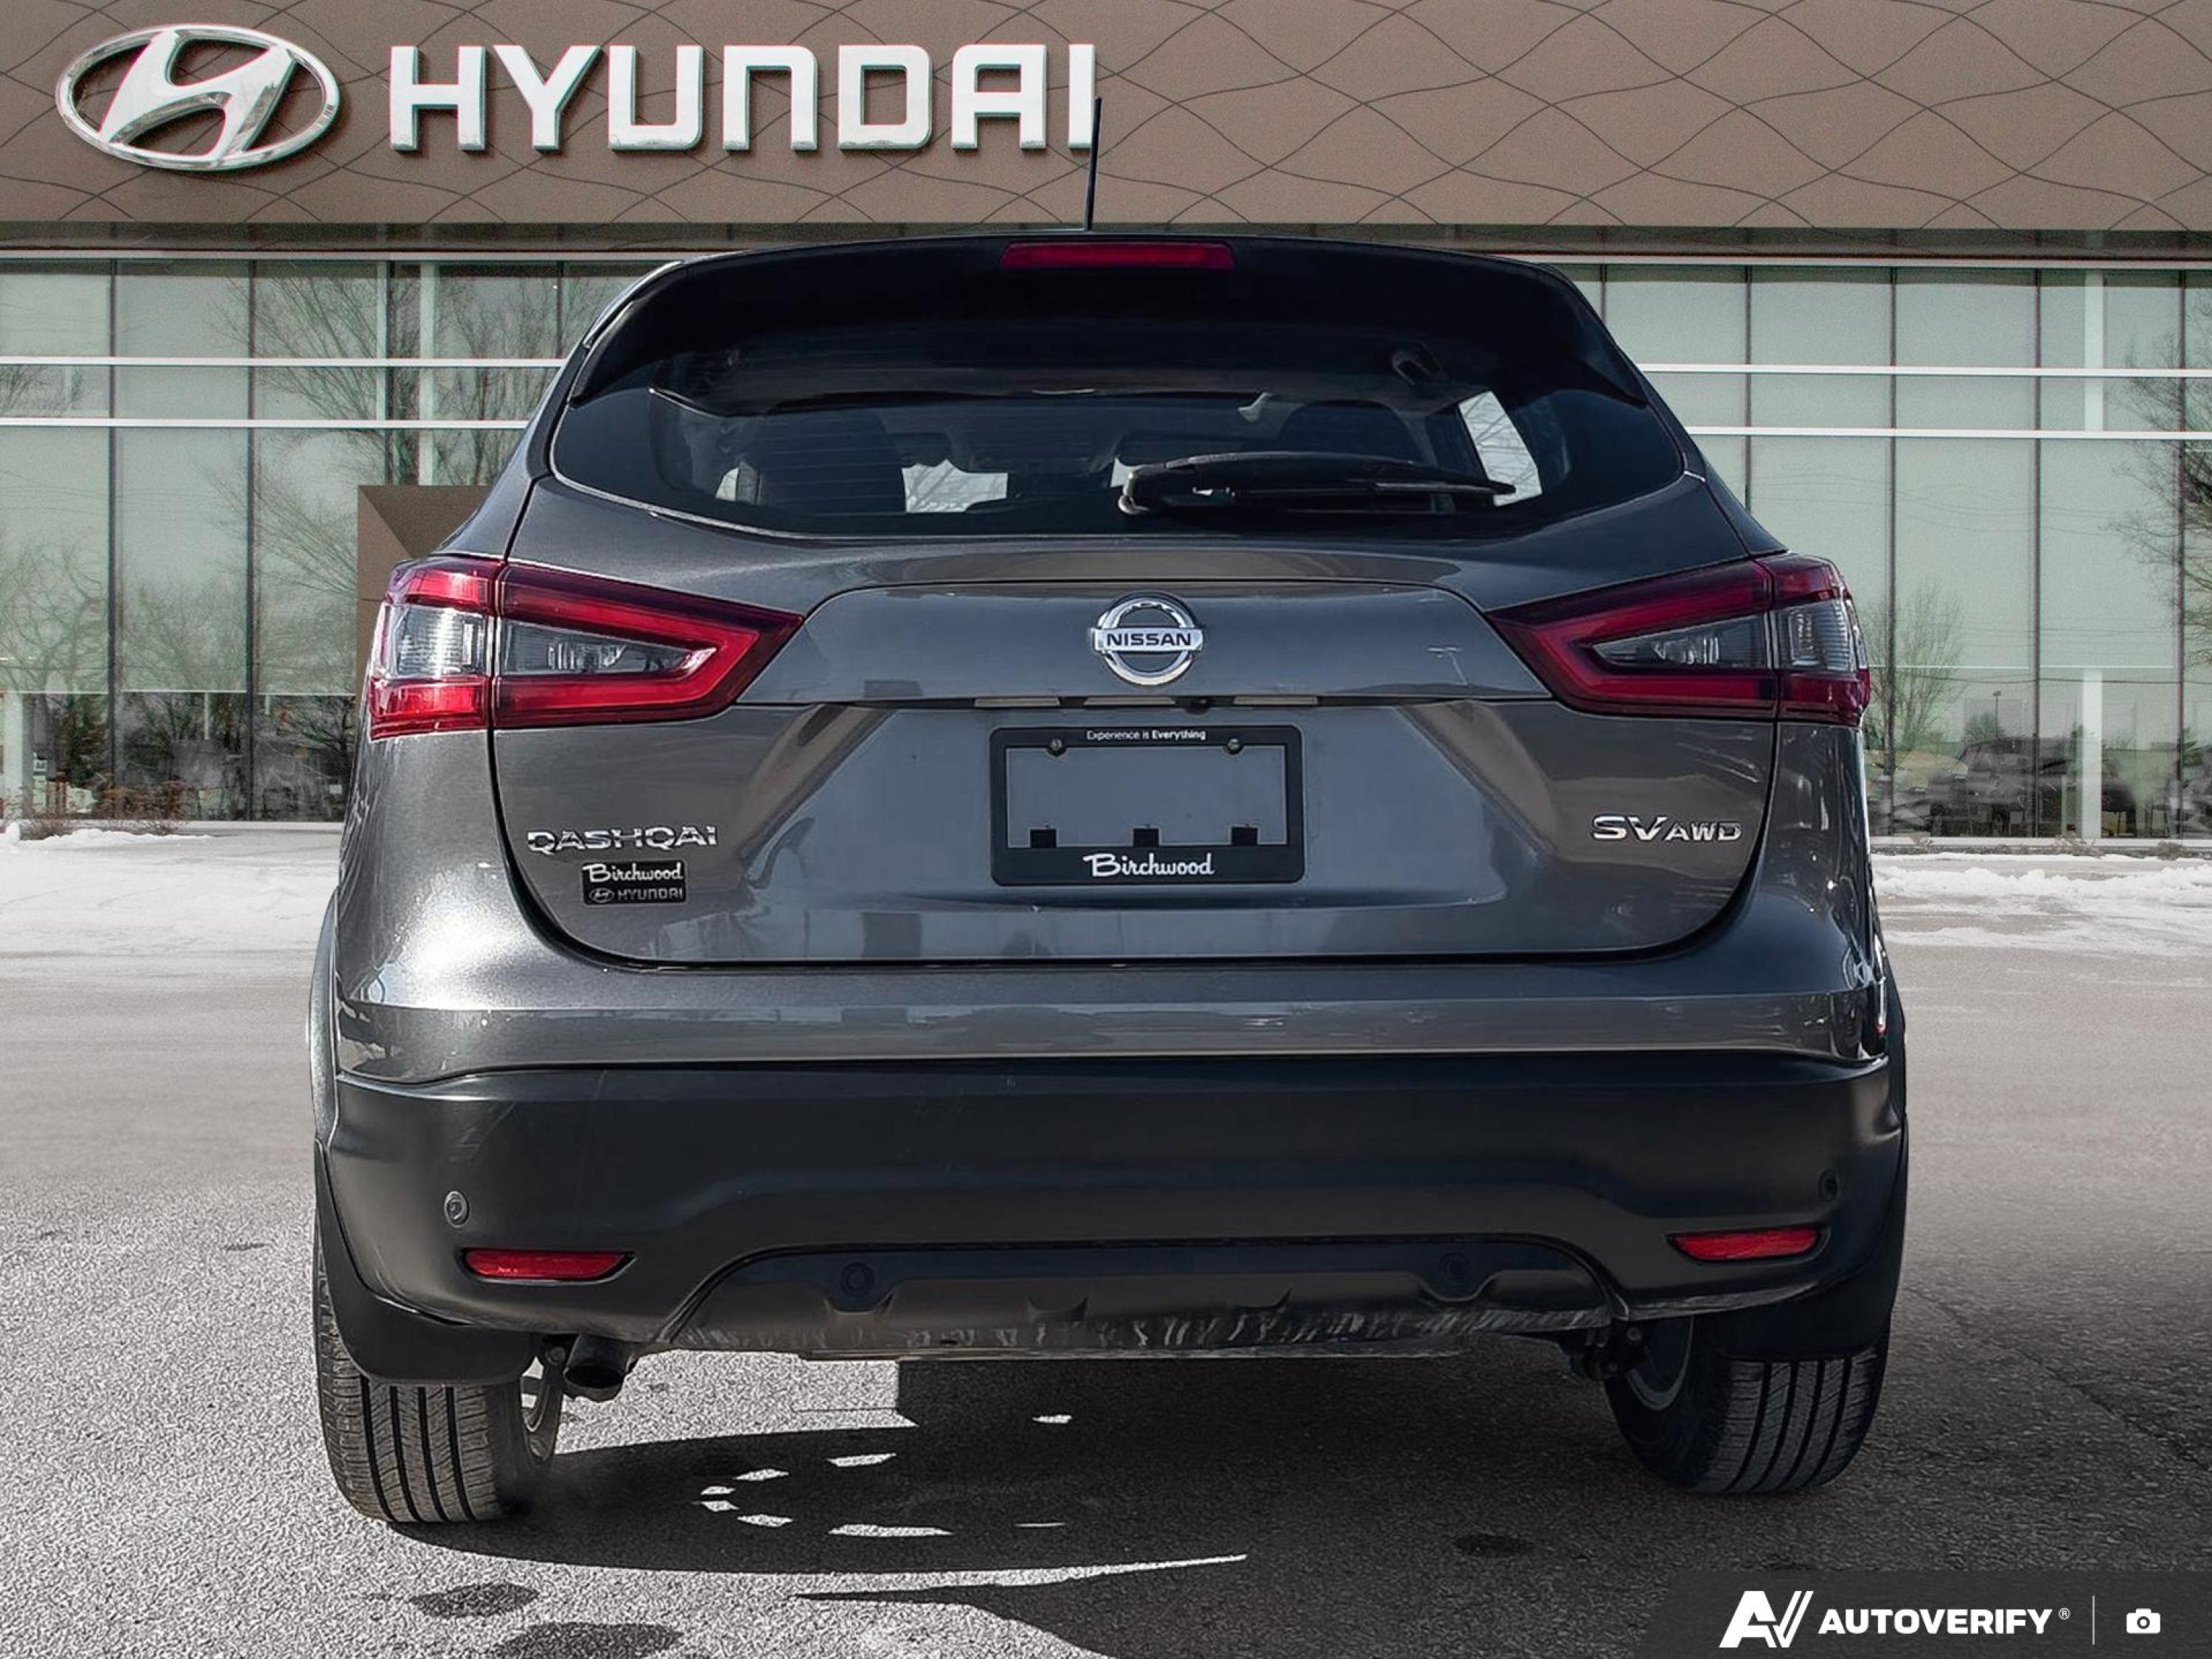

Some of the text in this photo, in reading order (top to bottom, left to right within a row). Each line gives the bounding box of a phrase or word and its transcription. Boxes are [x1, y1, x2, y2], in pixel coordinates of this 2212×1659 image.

[389, 44, 1095, 150] HYUNDAI
[1107, 633, 1191, 646] NISSAN
[1087, 730, 1206, 740] Experience is Everything
[526, 824, 718, 855] QASHQAI
[1593, 815, 1742, 841] SV AWD
[582, 862, 683, 883] Birchwood
[1082, 852, 1215, 877] Birchwood
[617, 887, 684, 900] HYUNDAI
